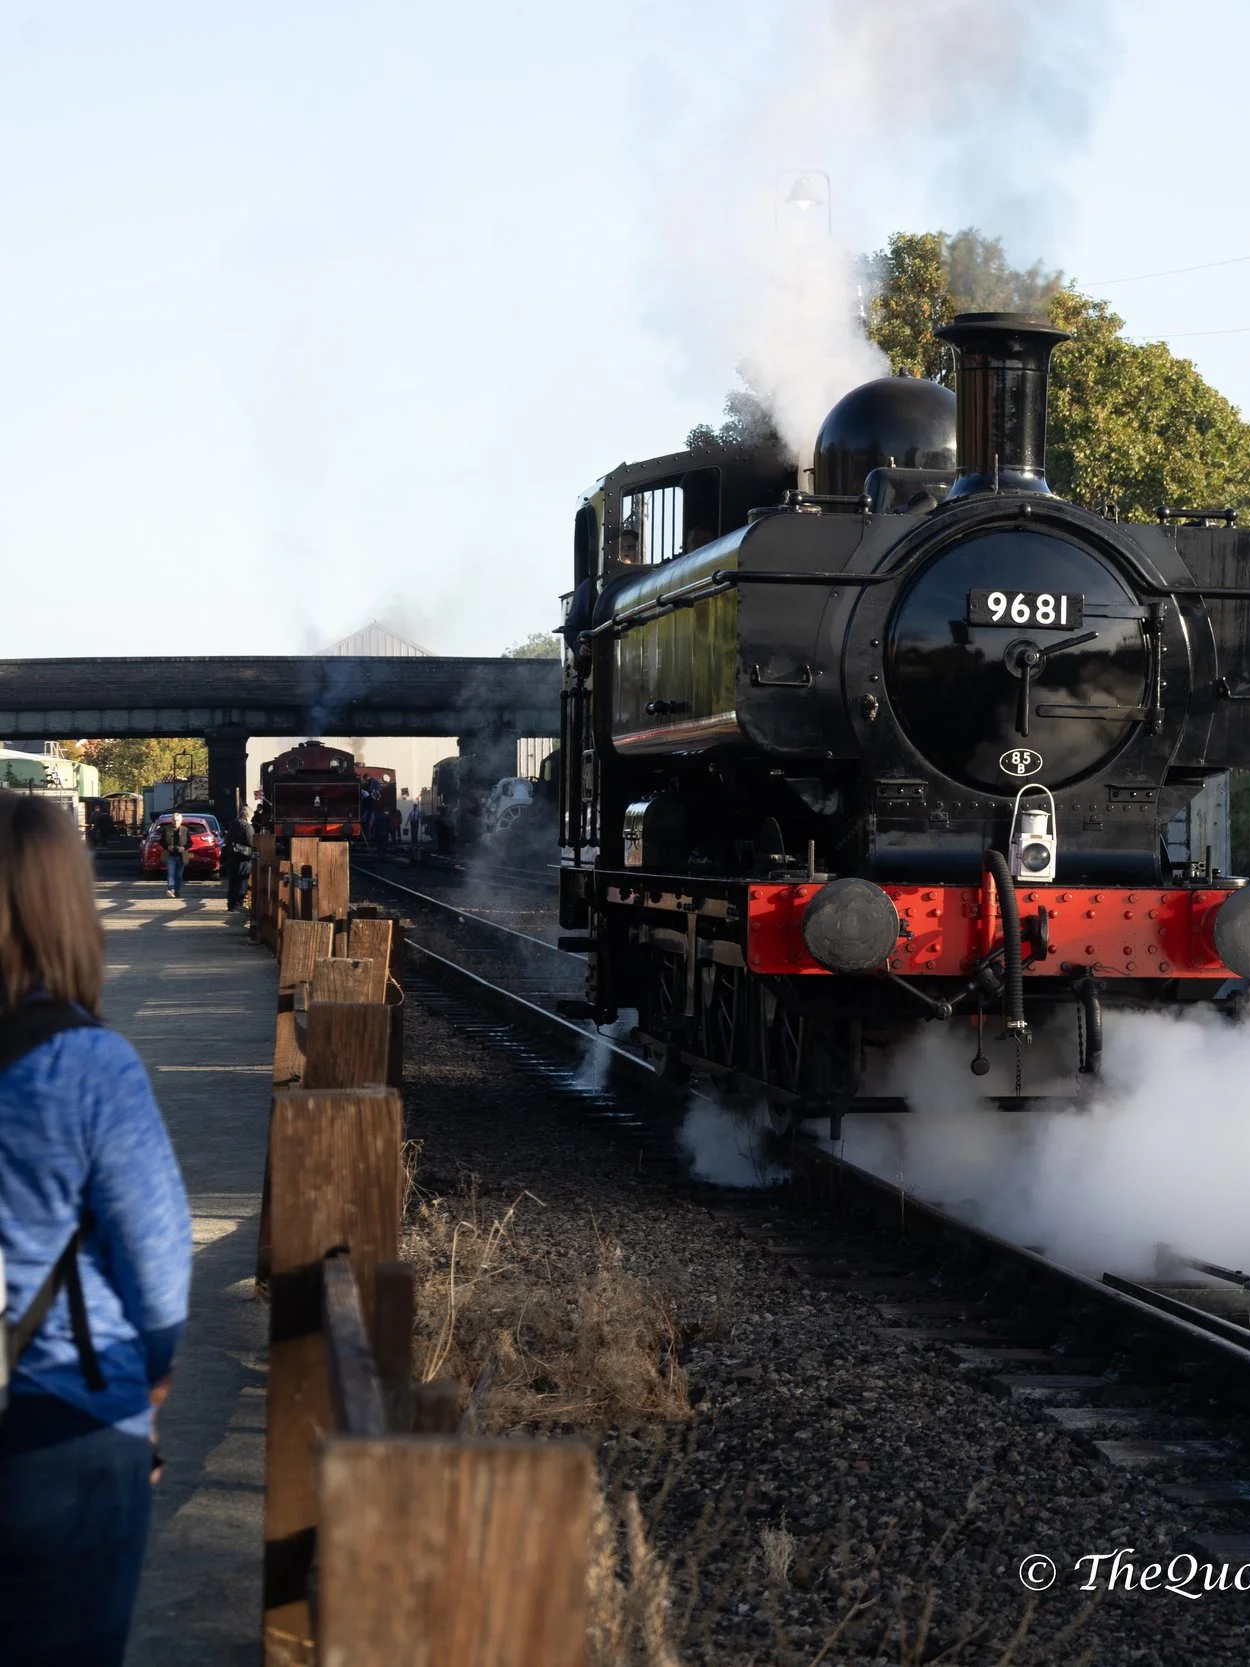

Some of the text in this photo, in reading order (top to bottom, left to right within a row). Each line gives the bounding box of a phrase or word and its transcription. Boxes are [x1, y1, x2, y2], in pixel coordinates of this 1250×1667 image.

[987, 591, 1068, 625] 9681
[1011, 751, 1031, 765] 85
[1017, 763, 1026, 774] B
